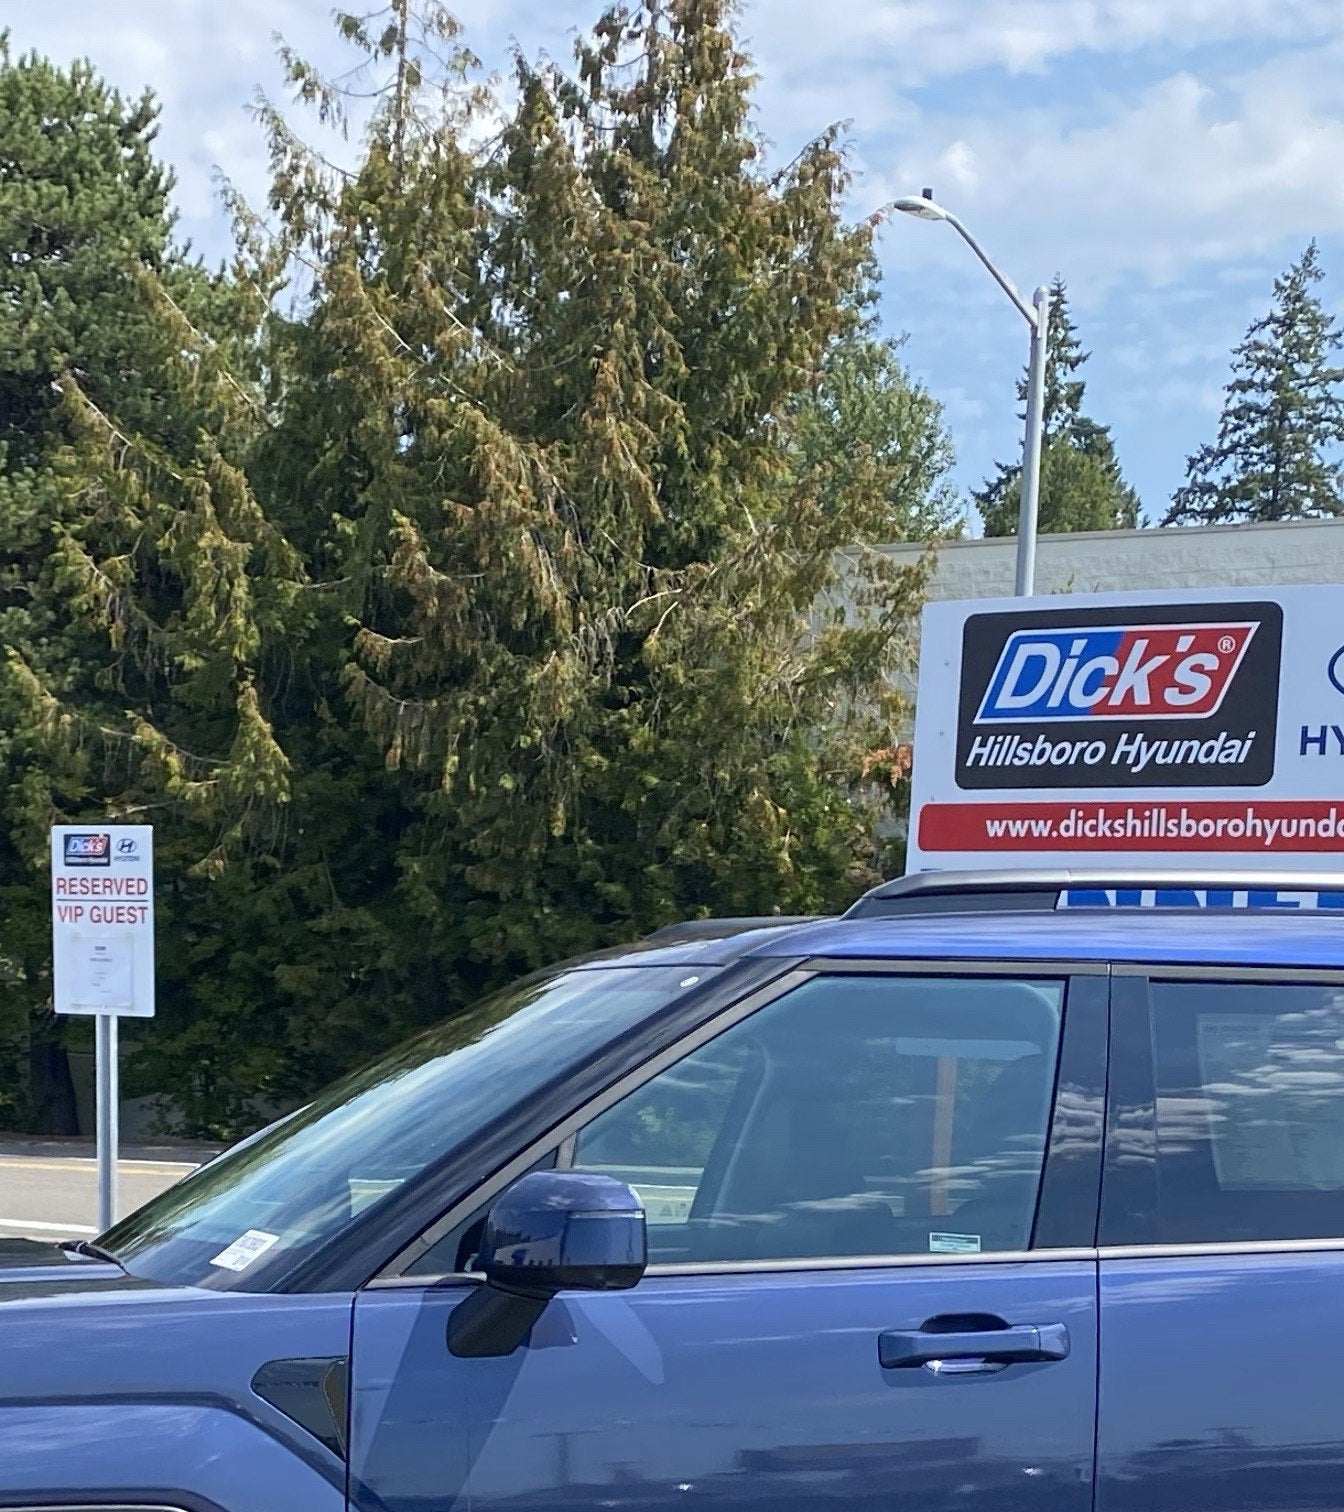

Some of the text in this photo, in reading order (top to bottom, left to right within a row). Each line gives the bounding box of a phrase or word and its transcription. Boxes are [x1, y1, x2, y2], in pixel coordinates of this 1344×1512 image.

[965, 730, 1257, 773] Hillsboro Hyundai
[56, 877, 149, 896] RESERVED
[57, 905, 149, 925] VIP GUEST
